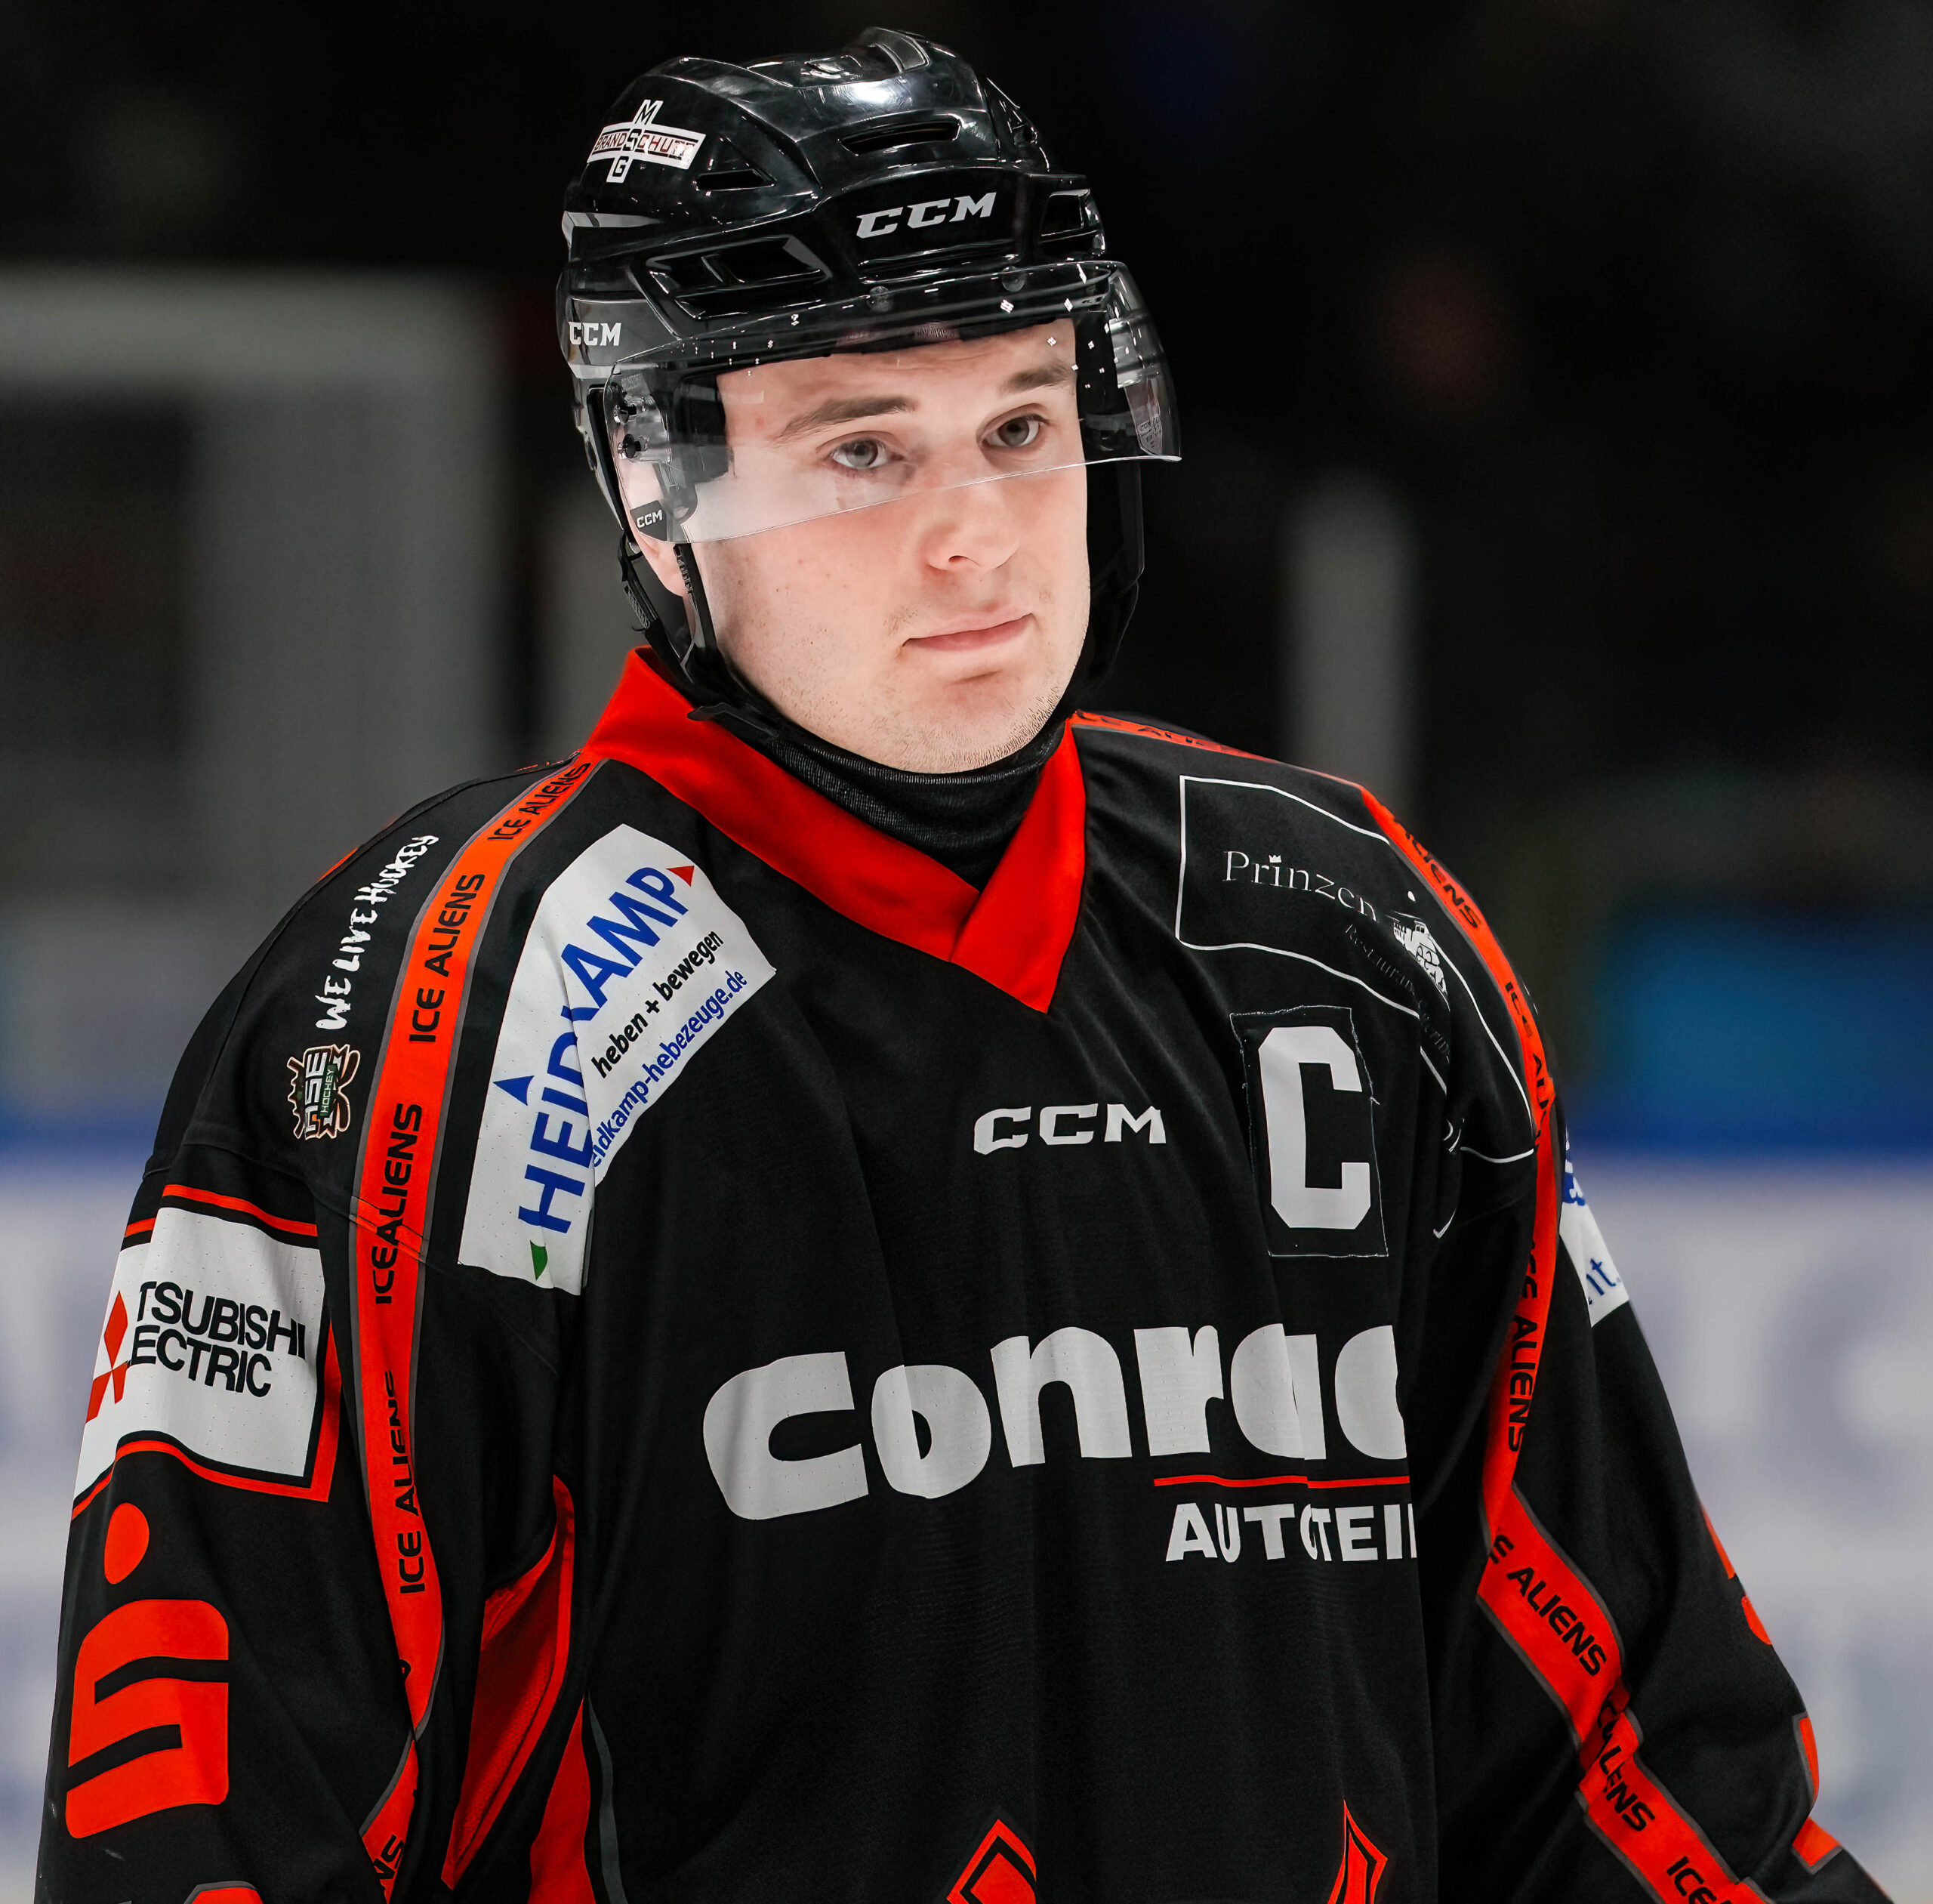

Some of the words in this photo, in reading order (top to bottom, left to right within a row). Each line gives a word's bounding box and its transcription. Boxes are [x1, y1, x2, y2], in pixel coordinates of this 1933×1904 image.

[856, 192, 997, 239] CCM
[569, 321, 621, 347] CCM
[636, 509, 663, 529] CCM
[487, 819, 532, 841] ICE
[518, 762, 592, 816] ALIENS
[1222, 850, 1380, 923] Prinzen
[332, 907, 378, 972] LIVE
[424, 873, 485, 978] ALIENS
[315, 975, 352, 1030] WE
[408, 987, 445, 1043] ICE
[591, 1013, 649, 1079] heben
[652, 930, 724, 1001] bewegen
[973, 1103, 1167, 1156] CCM
[1258, 1026, 1372, 1230] C
[376, 1103, 423, 1248] ALIENS
[371, 1245, 399, 1304] ICE
[396, 1530, 426, 1594] ICE
[1506, 1566, 1607, 1677] ALIENS
